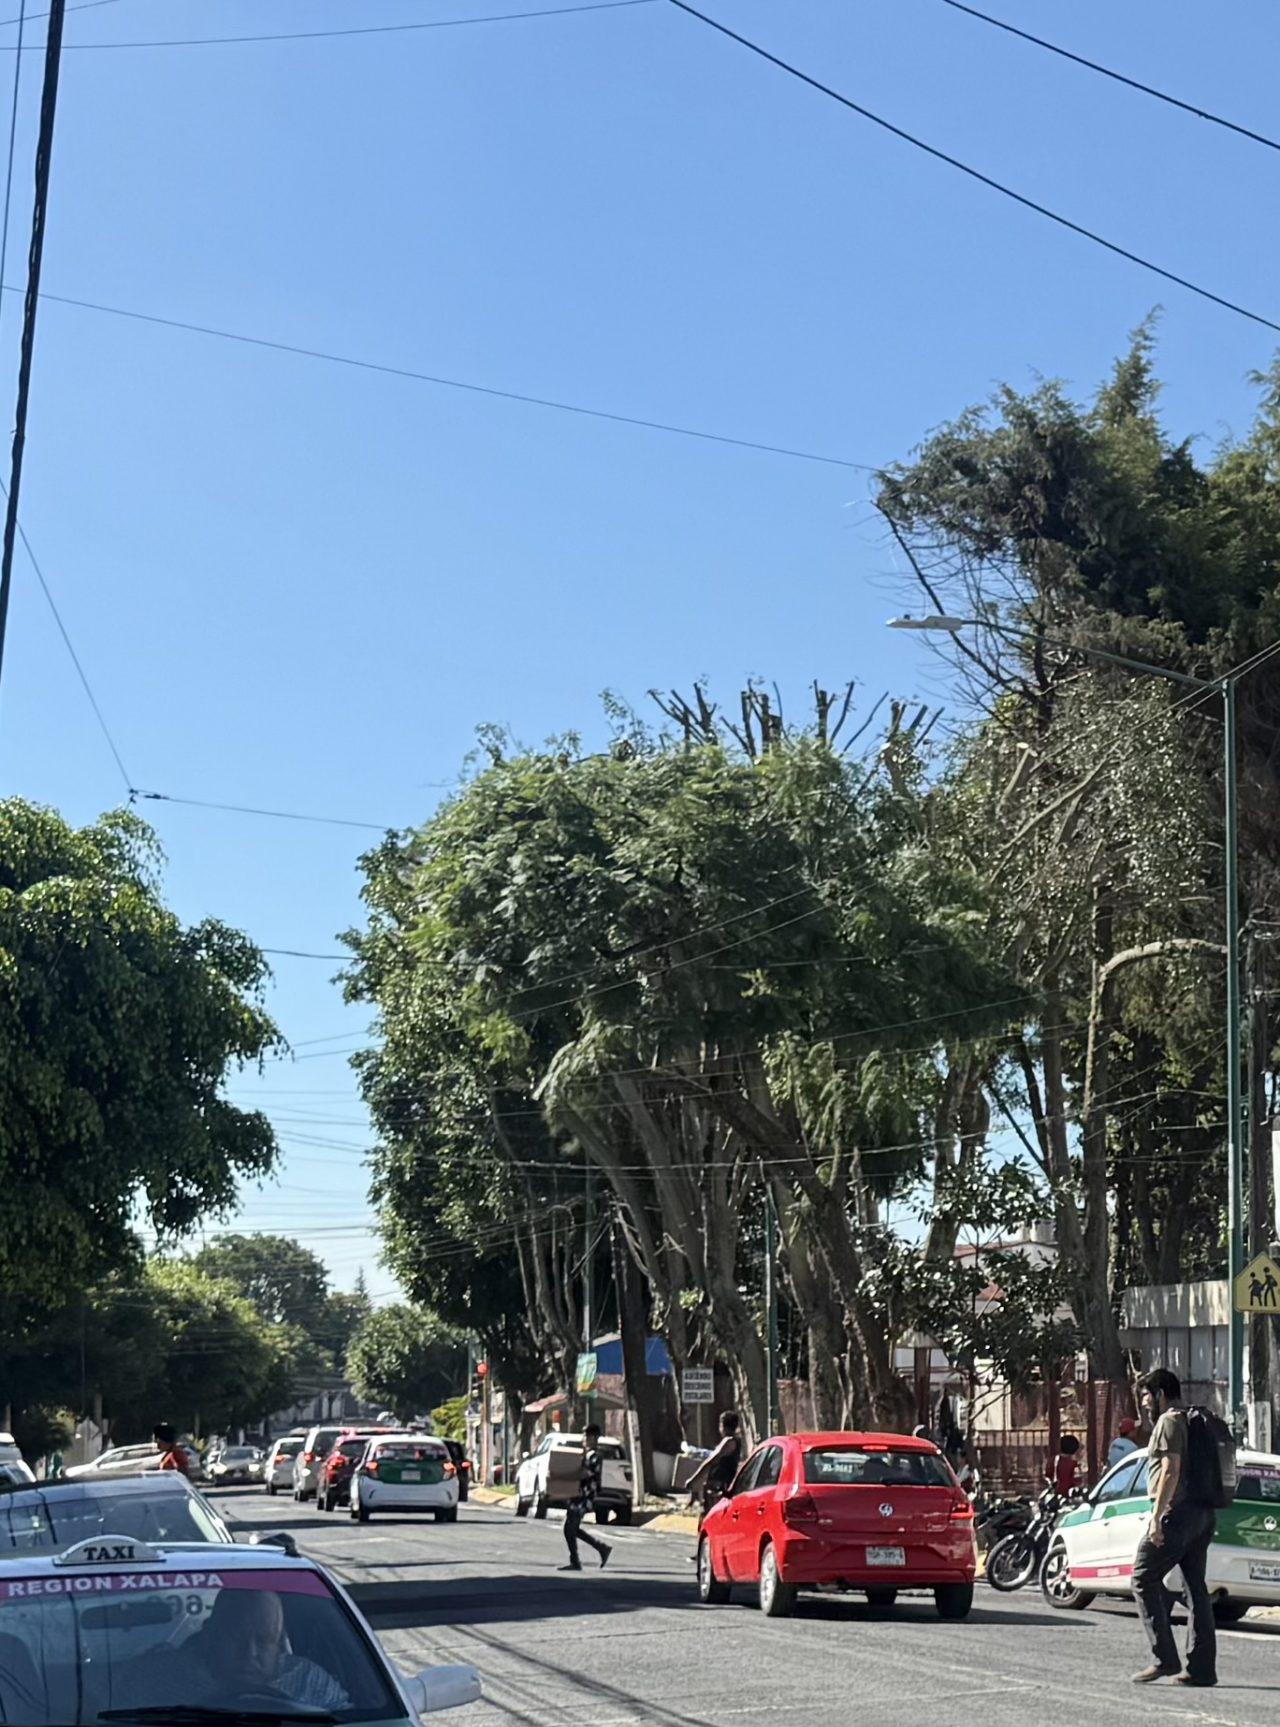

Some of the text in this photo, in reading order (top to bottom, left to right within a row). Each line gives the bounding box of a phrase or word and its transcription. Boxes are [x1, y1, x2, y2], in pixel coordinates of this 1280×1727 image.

[83, 1545, 136, 1561] TAXI
[8, 1573, 224, 1597] REGION XALAPA
